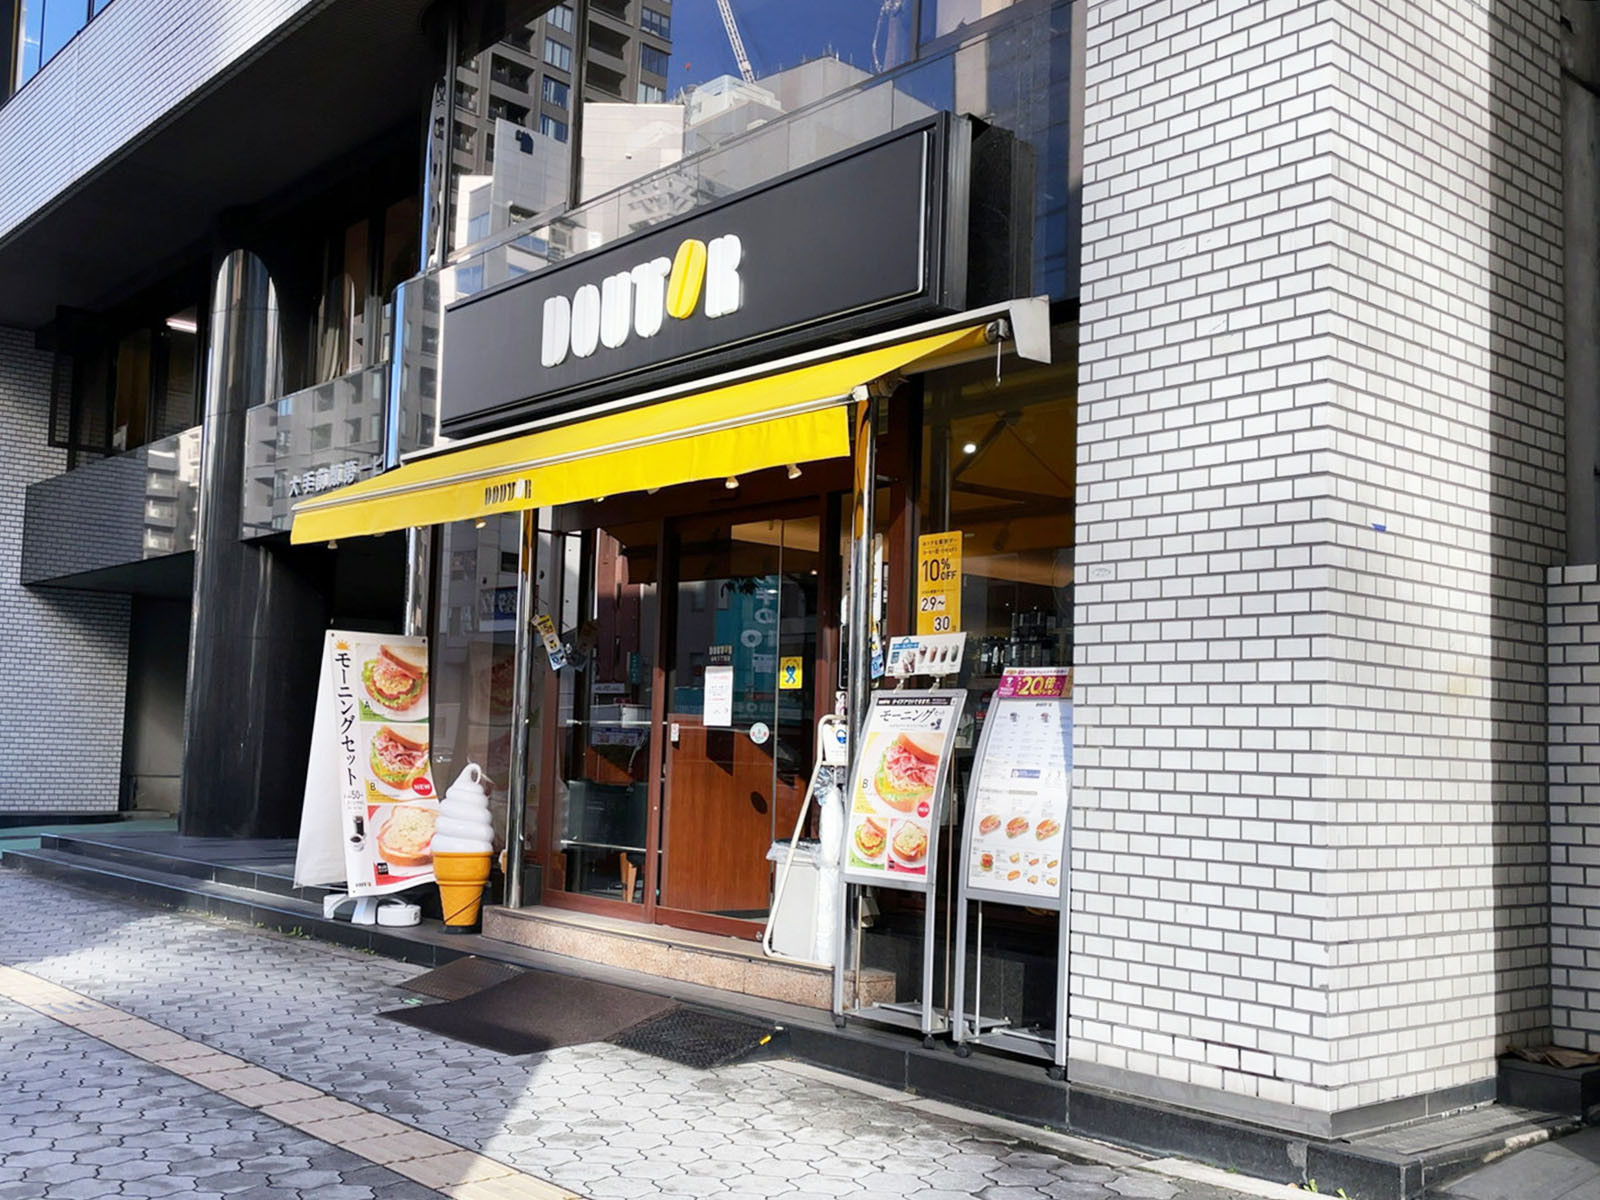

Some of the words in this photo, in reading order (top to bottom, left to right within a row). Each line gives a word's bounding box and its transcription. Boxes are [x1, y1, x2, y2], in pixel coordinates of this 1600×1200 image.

[541, 234, 742, 367] DOUTOR
[484, 477, 532, 506] DOUTOR
[940, 570, 957, 581] OFF
[934, 615, 950, 632] 30
[364, 700, 371, 709] A
[335, 652, 357, 786] モーニングセット
[370, 782, 376, 791] B
[413, 783, 431, 792] NEW
[862, 778, 869, 789] B
